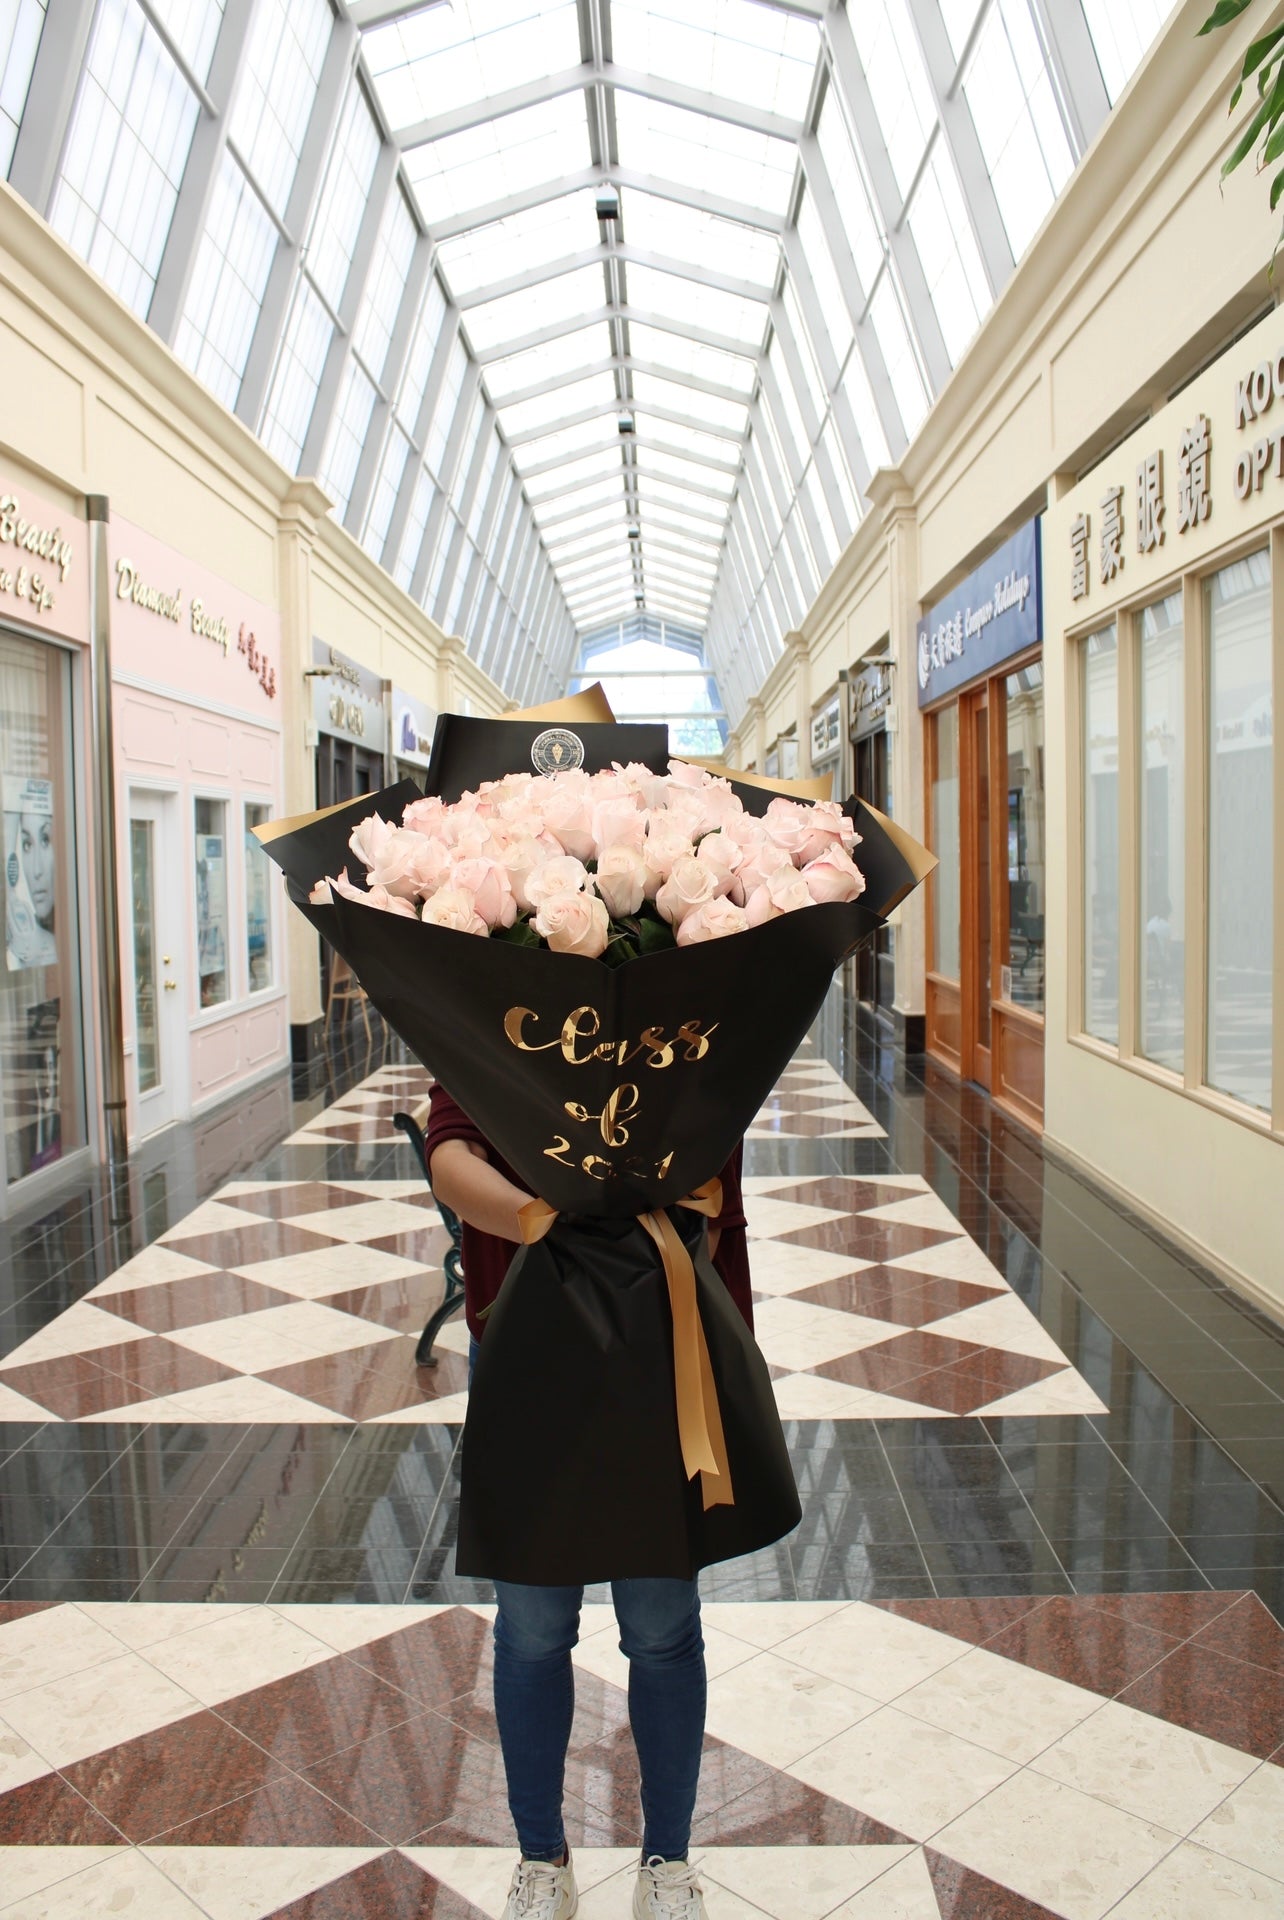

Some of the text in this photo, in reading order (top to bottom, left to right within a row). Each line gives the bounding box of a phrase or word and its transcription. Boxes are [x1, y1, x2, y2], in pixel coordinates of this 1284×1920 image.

[0, 494, 73, 582] Beauty
[1070, 413, 1213, 601] 富豪眼鏡
[116, 557, 232, 659] Diamond Beauty
[504, 1006, 720, 1068] Class
[564, 1083, 642, 1147] of
